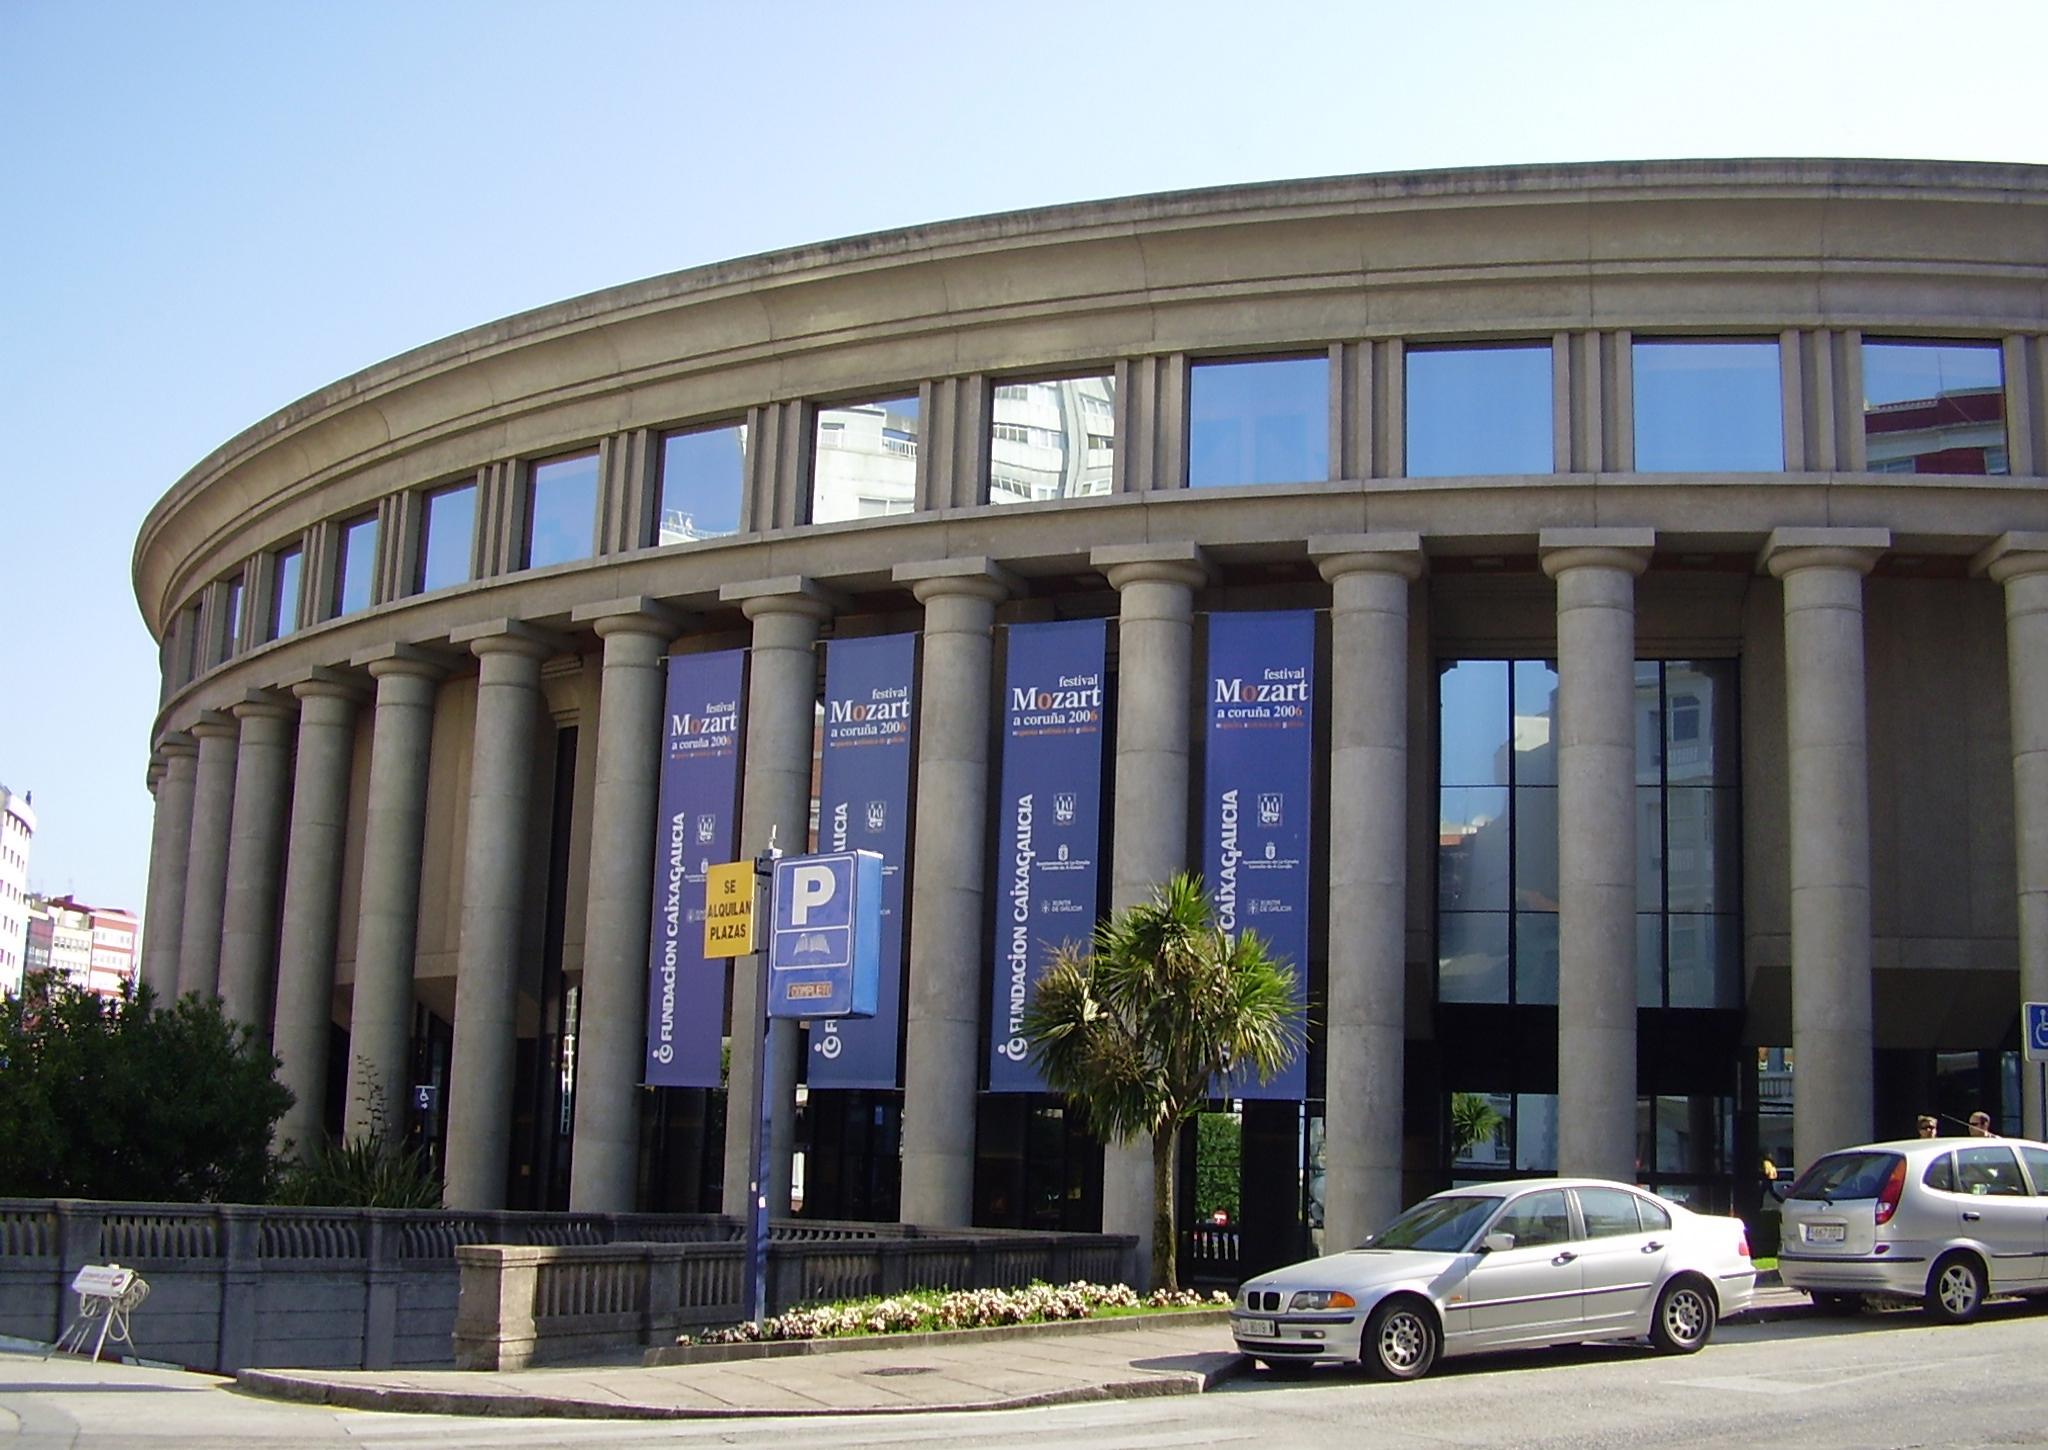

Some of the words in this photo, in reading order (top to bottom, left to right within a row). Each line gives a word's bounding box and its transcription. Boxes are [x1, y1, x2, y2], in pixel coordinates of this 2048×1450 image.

[1059, 673, 1099, 688] festival
[1264, 667, 1305, 680] festival
[872, 686, 908, 700] festival
[1011, 685, 1102, 712] Mozart
[1214, 679, 1309, 704] Mozart
[705, 700, 736, 714] festival
[829, 697, 911, 724] Mozart
[1217, 709, 1225, 719] a
[1227, 706, 1271, 719] coruña
[1273, 704, 1303, 718] 2006
[671, 711, 737, 737] Mozart
[1013, 716, 1021, 726] a
[1023, 712, 1066, 726] coruña
[1068, 709, 1098, 724] 2006
[830, 728, 838, 738] a
[839, 723, 878, 737] coruña
[880, 720, 907, 735] 2006
[671, 742, 677, 751] a
[724, 879, 736, 895] SE
[791, 865, 836, 926] P
[708, 900, 751, 918] ALQUILAN
[710, 923, 746, 941] PLAZAS
